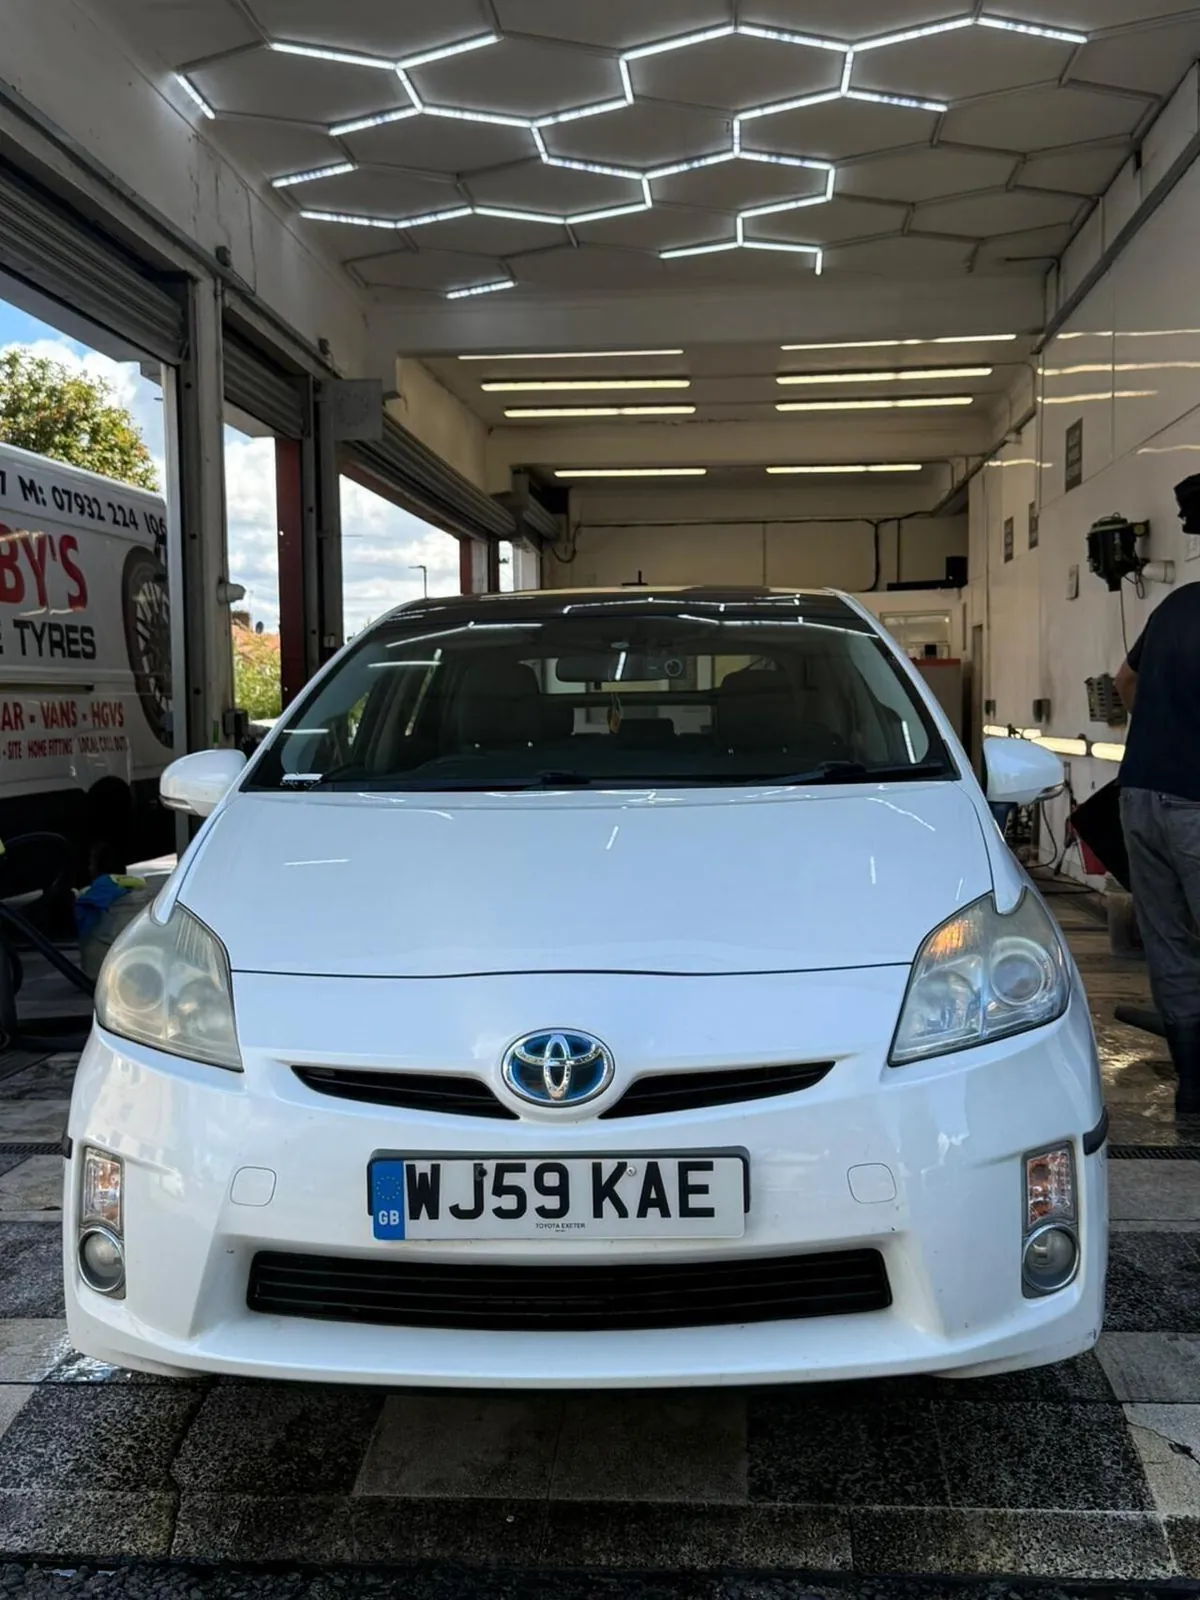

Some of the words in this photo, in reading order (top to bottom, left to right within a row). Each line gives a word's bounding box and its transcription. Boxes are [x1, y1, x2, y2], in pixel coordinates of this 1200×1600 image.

[18, 475, 47, 506] M:
[52, 486, 105, 521] 07932
[107, 502, 139, 530] 224
[13, 619, 97, 660] TYRES
[41, 700, 77, 729] VANS
[91, 701, 124, 728] HGVS
[405, 1162, 570, 1220] WJ59
[591, 1161, 716, 1220] KAE
[379, 1209, 399, 1225] GB
